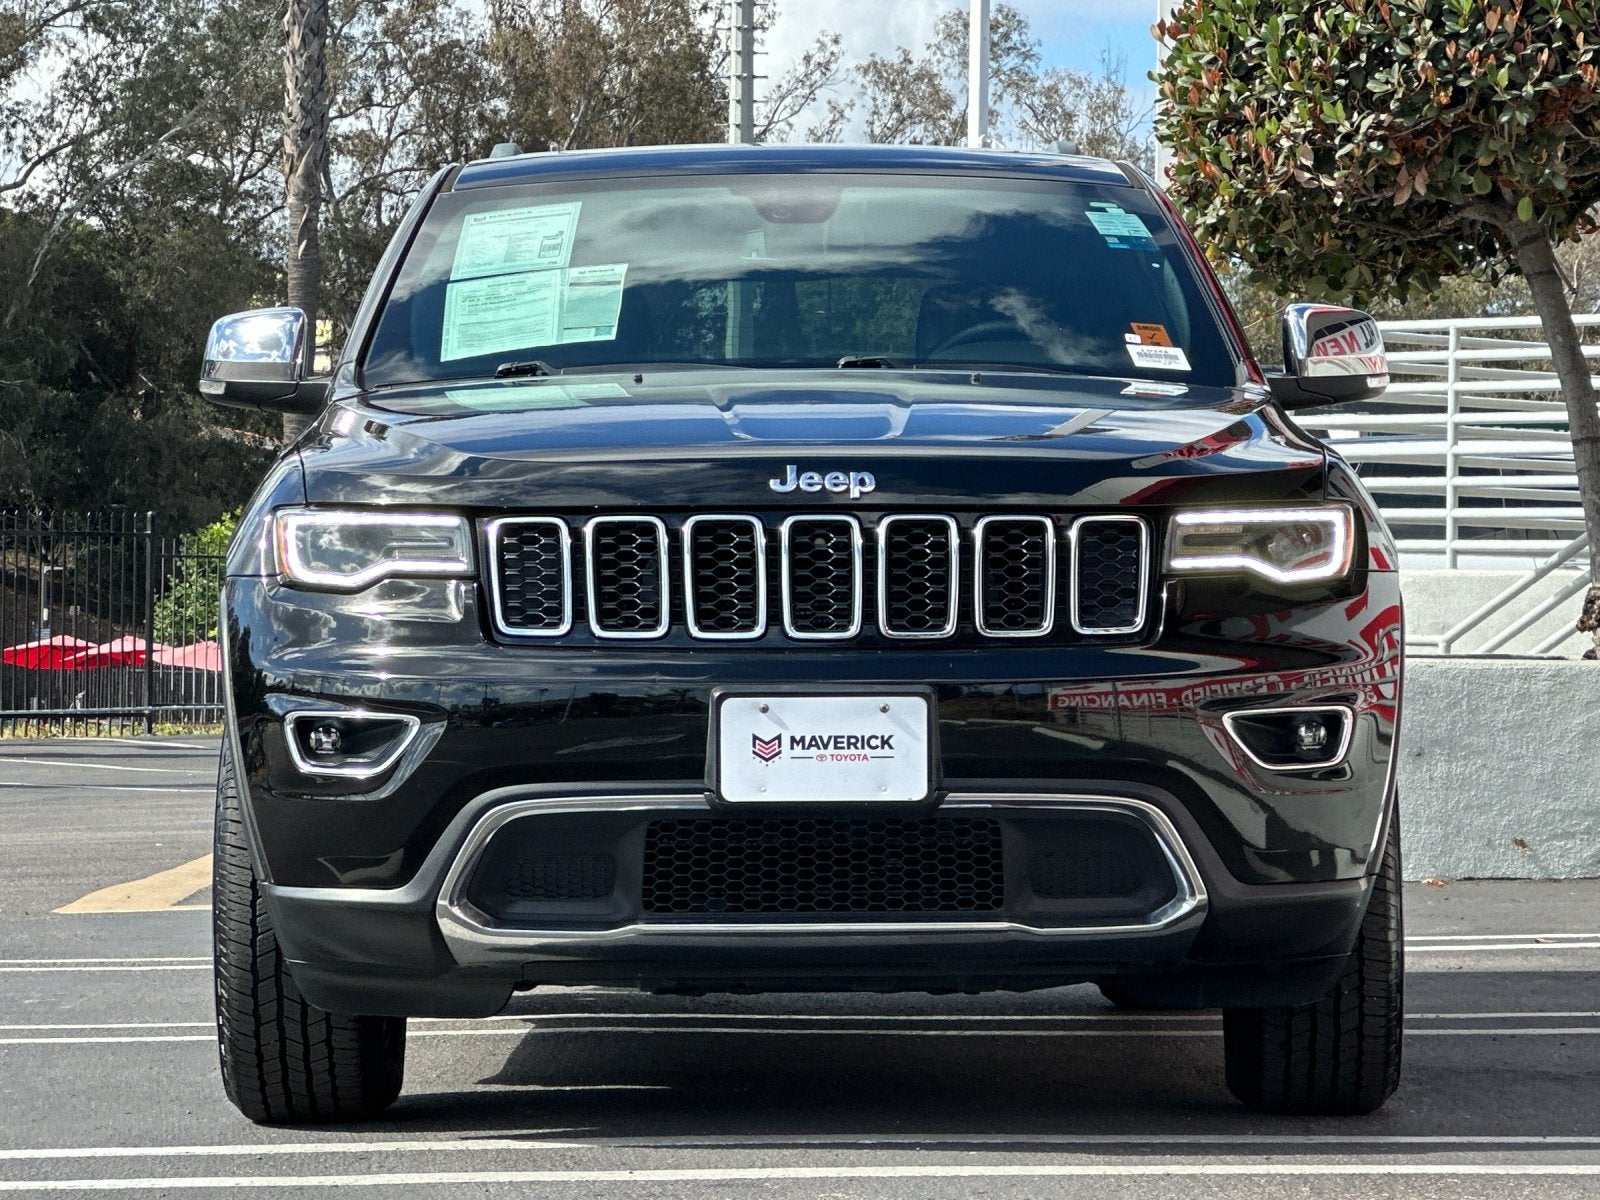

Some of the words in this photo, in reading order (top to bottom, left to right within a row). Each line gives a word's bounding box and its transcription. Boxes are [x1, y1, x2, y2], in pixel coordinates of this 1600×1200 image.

[769, 465, 876, 499] Jeep
[790, 734, 895, 750] MAVERICK
[829, 753, 869, 761] TOYOTA
